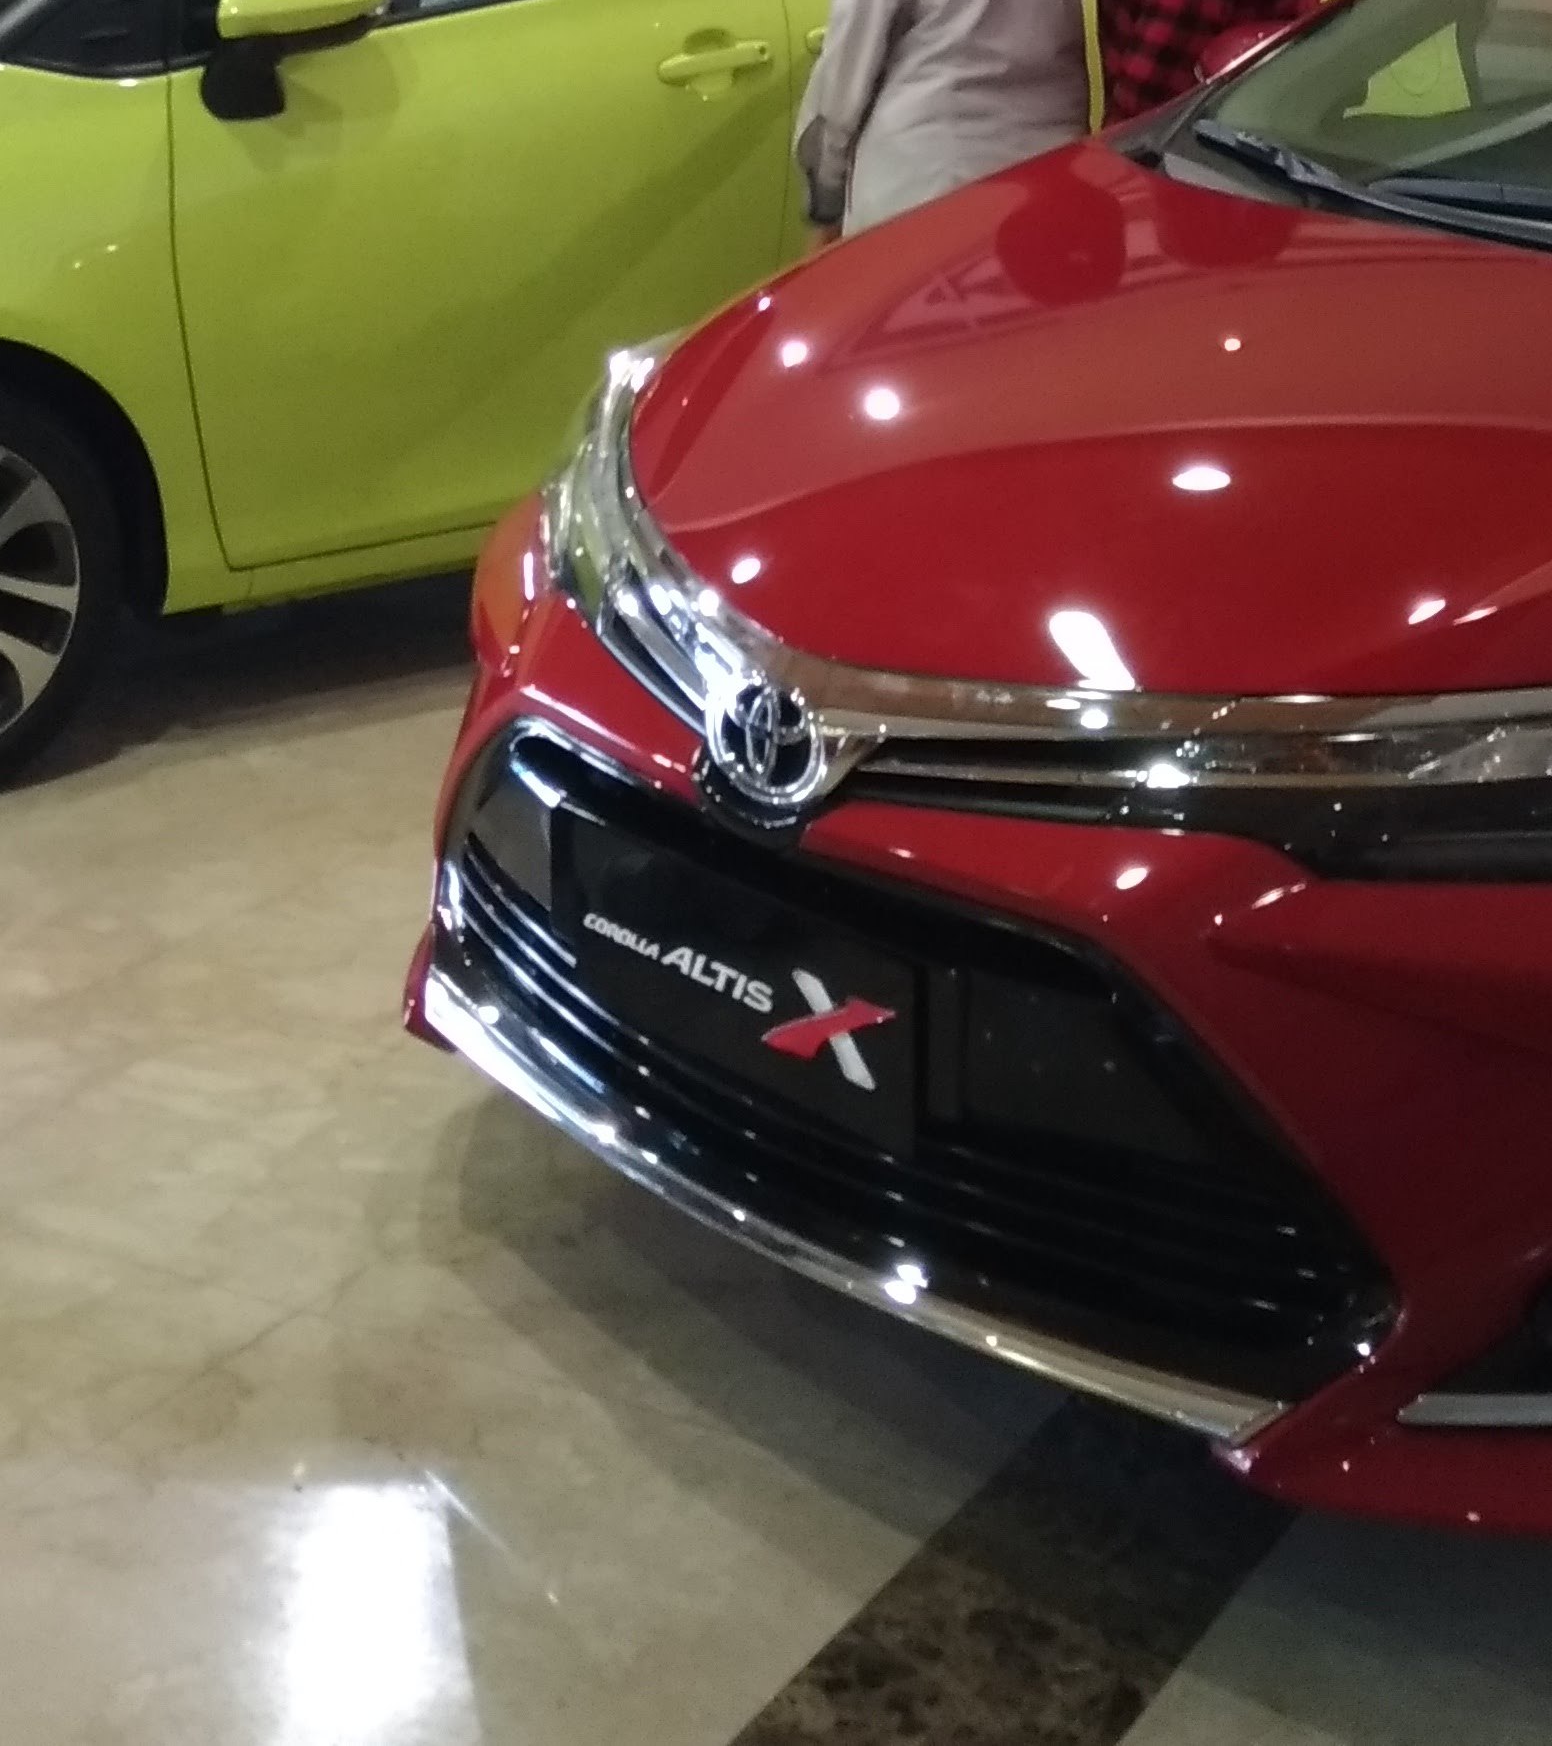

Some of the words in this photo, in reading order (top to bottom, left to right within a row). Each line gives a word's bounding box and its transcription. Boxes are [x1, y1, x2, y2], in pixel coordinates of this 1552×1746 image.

[582, 912, 661, 961] COROLLA
[660, 946, 774, 1014] ALTIS
[760, 967, 897, 1092] X
